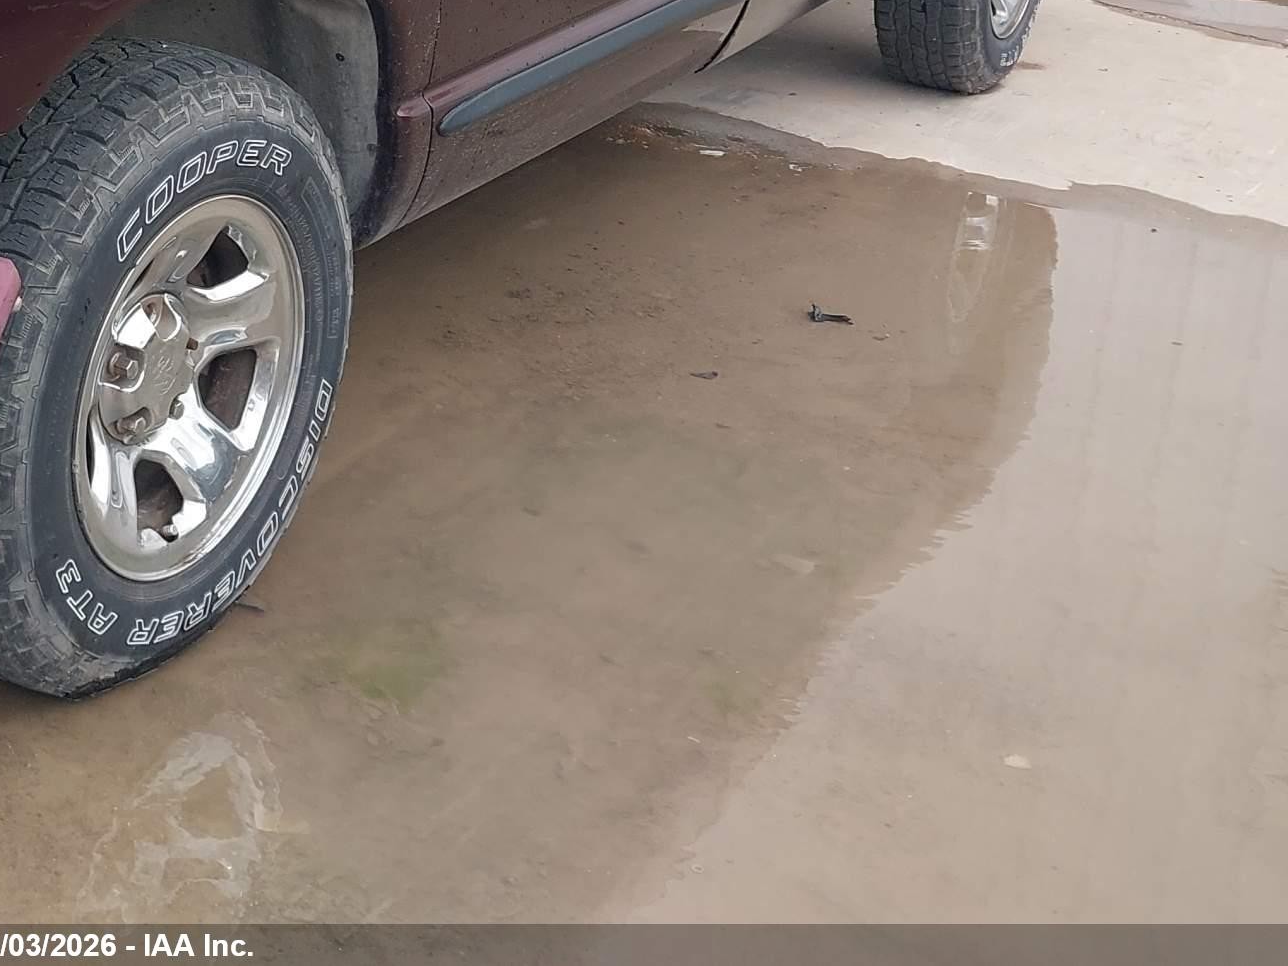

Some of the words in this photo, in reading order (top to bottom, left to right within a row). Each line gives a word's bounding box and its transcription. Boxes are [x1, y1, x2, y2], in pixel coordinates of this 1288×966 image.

[117, 139, 292, 262] COOPER
[126, 379, 333, 646] DISCOVERER
[55, 559, 119, 635] AT3
